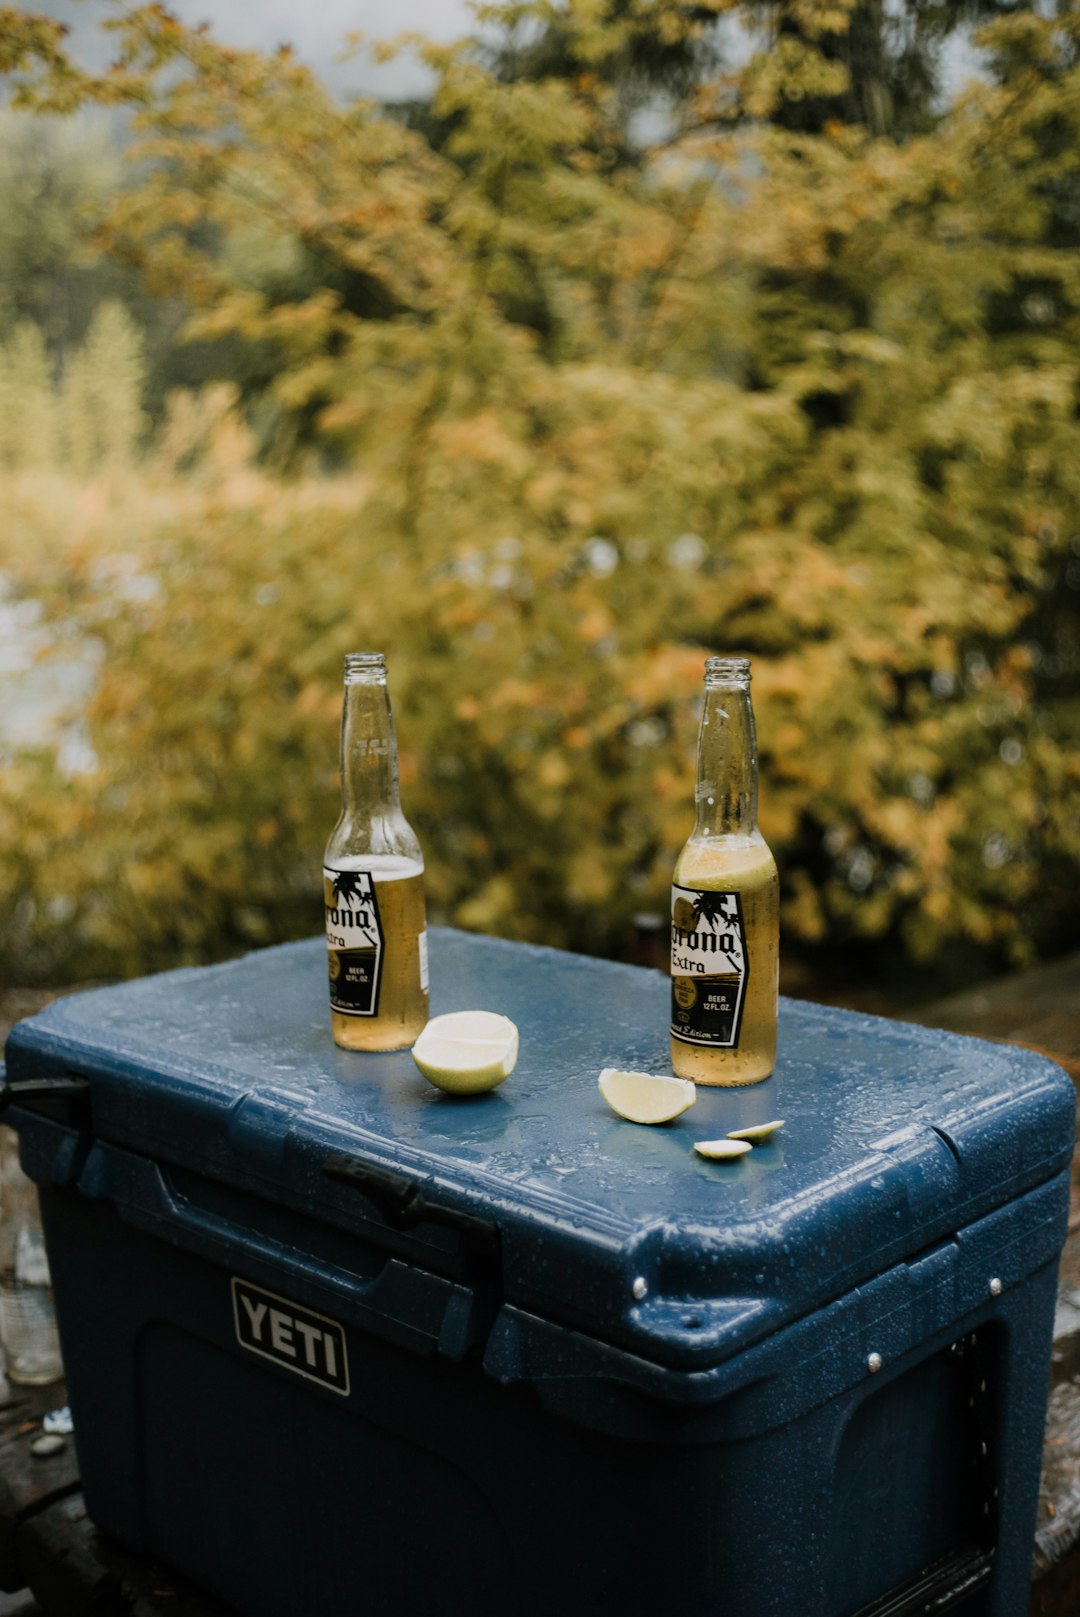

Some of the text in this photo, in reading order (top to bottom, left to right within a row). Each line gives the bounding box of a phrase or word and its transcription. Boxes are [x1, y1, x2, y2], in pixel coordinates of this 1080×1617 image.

[326, 905, 371, 929] rona
[328, 933, 346, 948] tra
[672, 925, 737, 954] orona
[349, 967, 365, 975] BEER
[708, 994, 727, 1003] BEER
[240, 1293, 338, 1378] YETI
